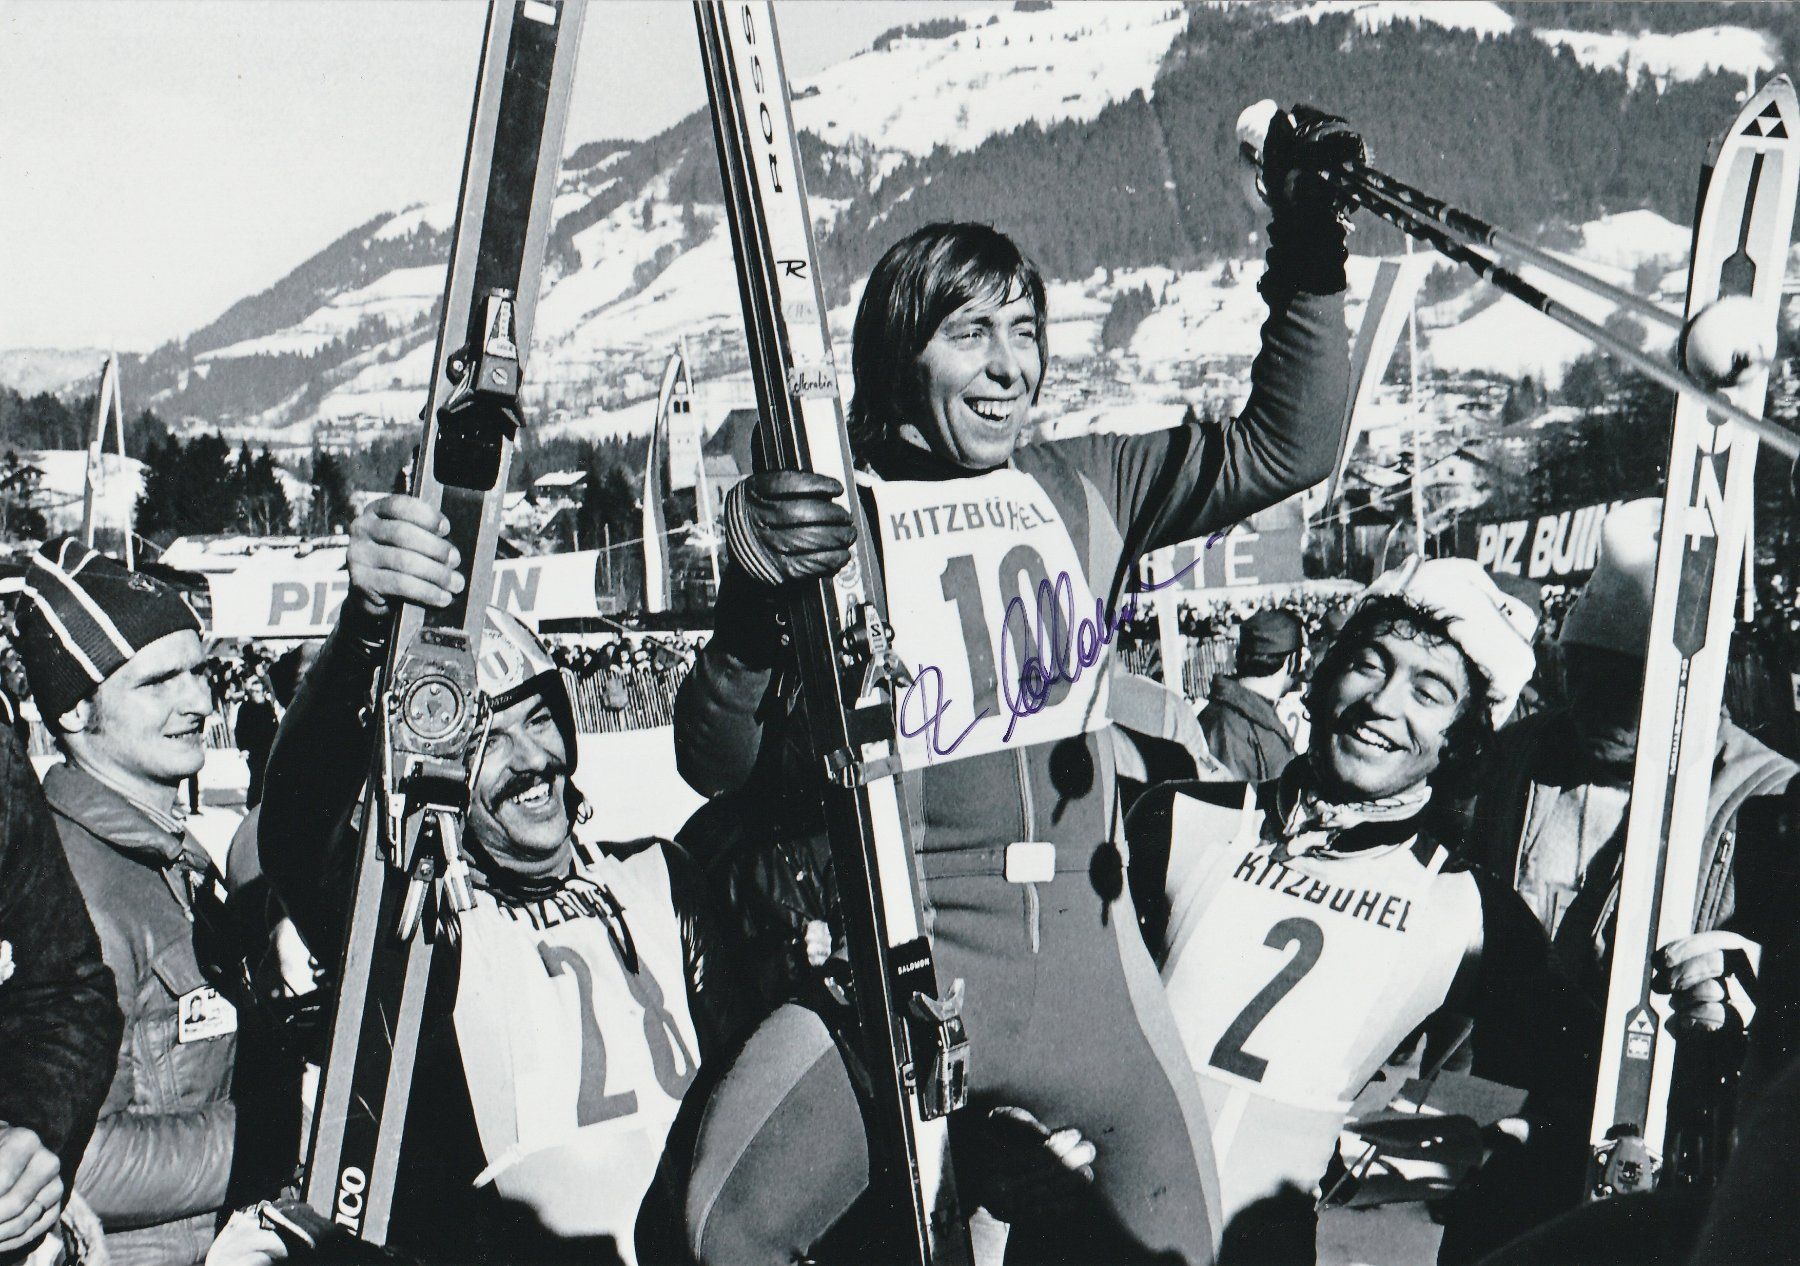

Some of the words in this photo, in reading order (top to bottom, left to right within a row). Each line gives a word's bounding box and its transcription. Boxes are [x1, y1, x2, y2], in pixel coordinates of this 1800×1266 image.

[889, 495, 1054, 541] KITZBÜHEL
[1477, 519, 1529, 576] PIZ
[939, 543, 1074, 720] 10
[898, 957, 931, 976] SALOMON
[1208, 917, 1325, 1084] 2
[536, 918, 699, 1128] 28
